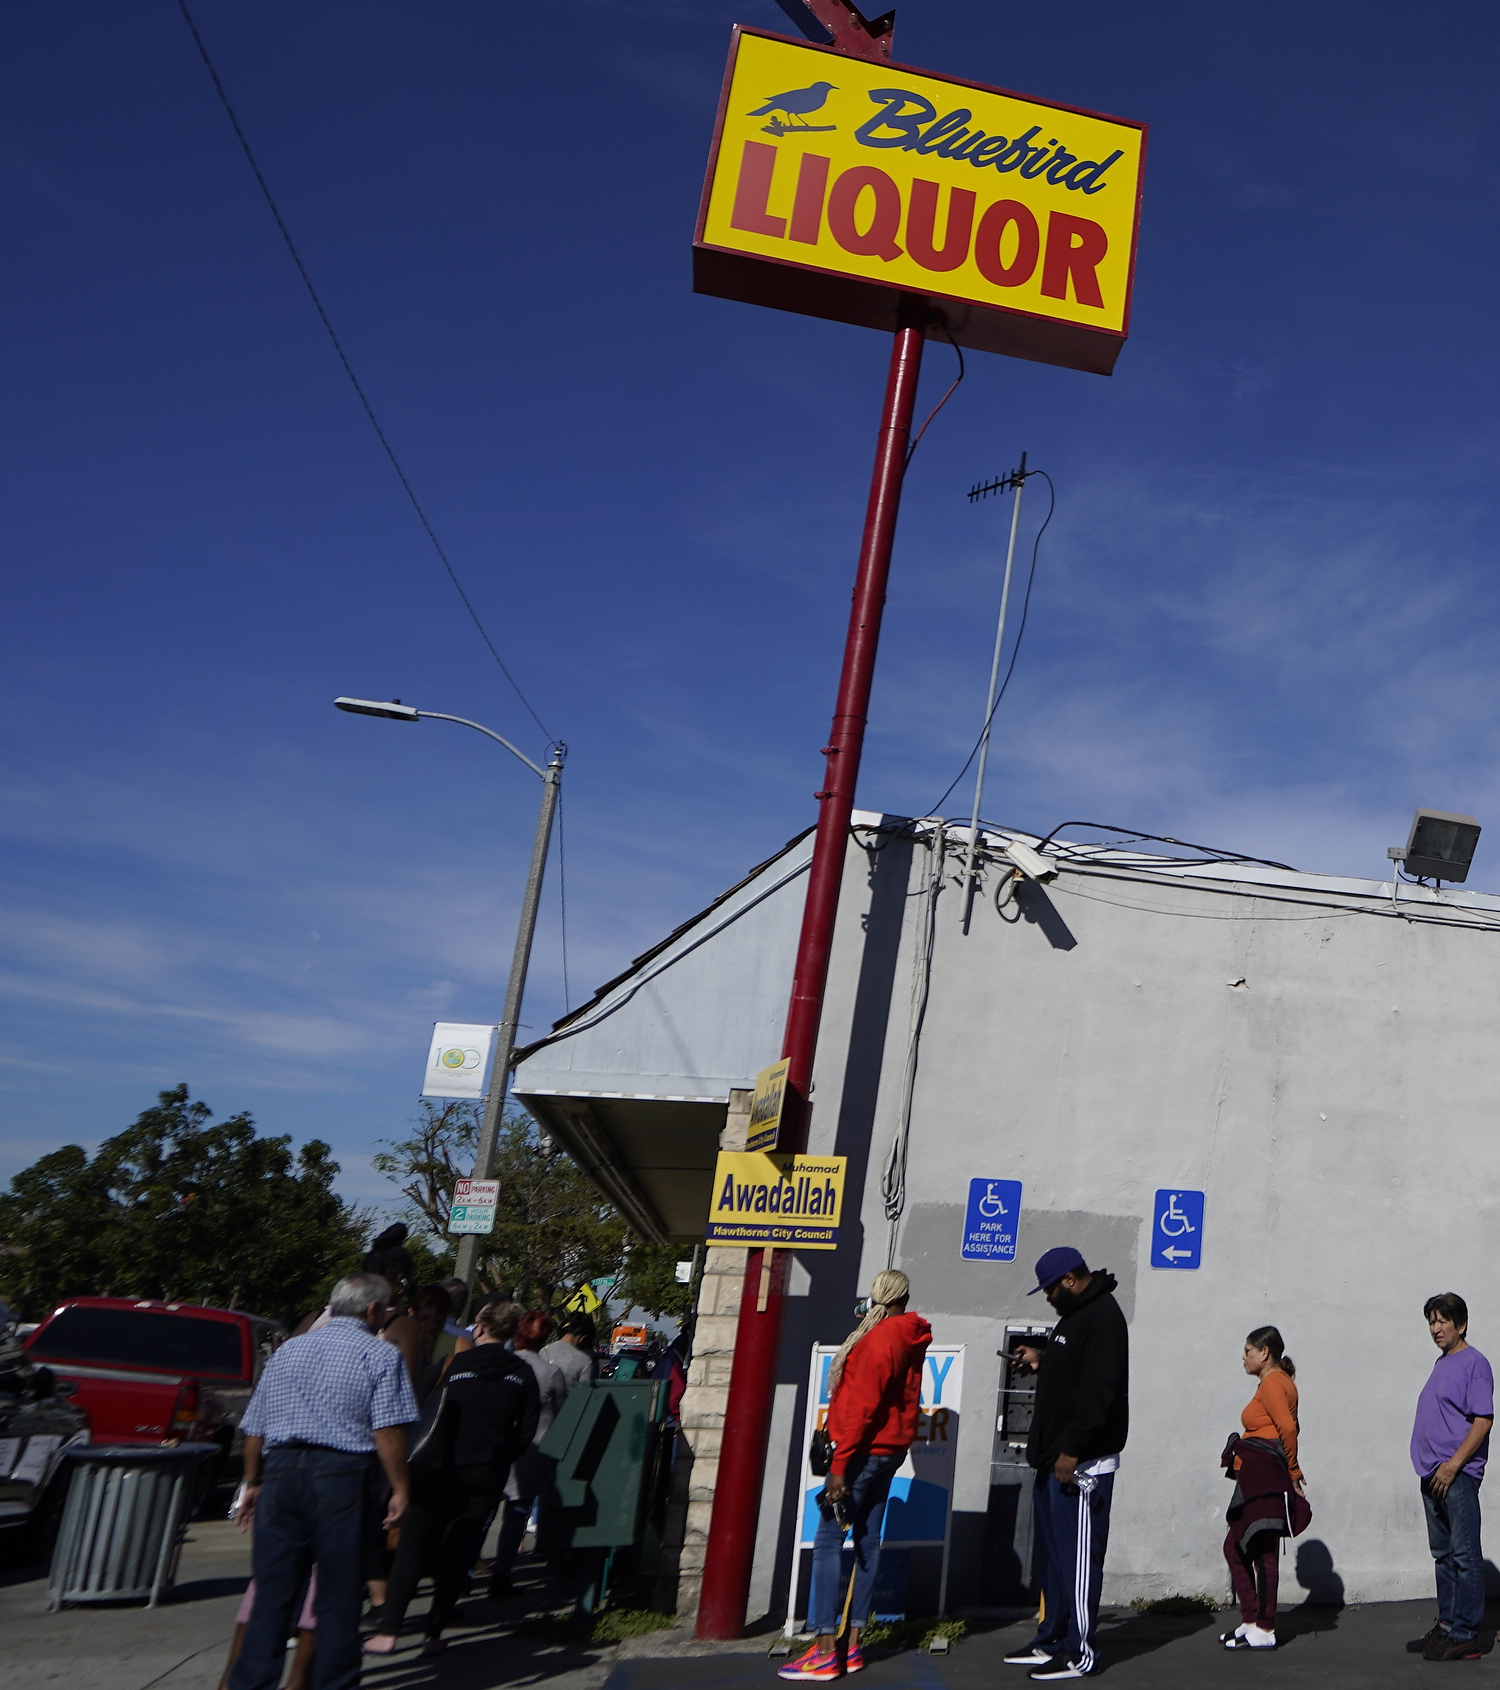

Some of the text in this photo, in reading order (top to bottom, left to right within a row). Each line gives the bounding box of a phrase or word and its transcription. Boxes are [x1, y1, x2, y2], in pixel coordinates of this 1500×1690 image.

[854, 87, 1124, 195] Bluebird
[730, 139, 1105, 309] LIQUOR
[782, 1162, 840, 1174] Muhamad
[456, 1182, 496, 1194] NO PARKING
[717, 1173, 836, 1216] Awadallah
[454, 1208, 465, 1220] 2
[466, 1214, 491, 1222] PARKING
[713, 1226, 833, 1240] Hawthorne City Council
[980, 1222, 1003, 1232] PARK
[969, 1232, 1012, 1243] HERE FOR
[963, 1243, 1015, 1254] ASSISTANCE
